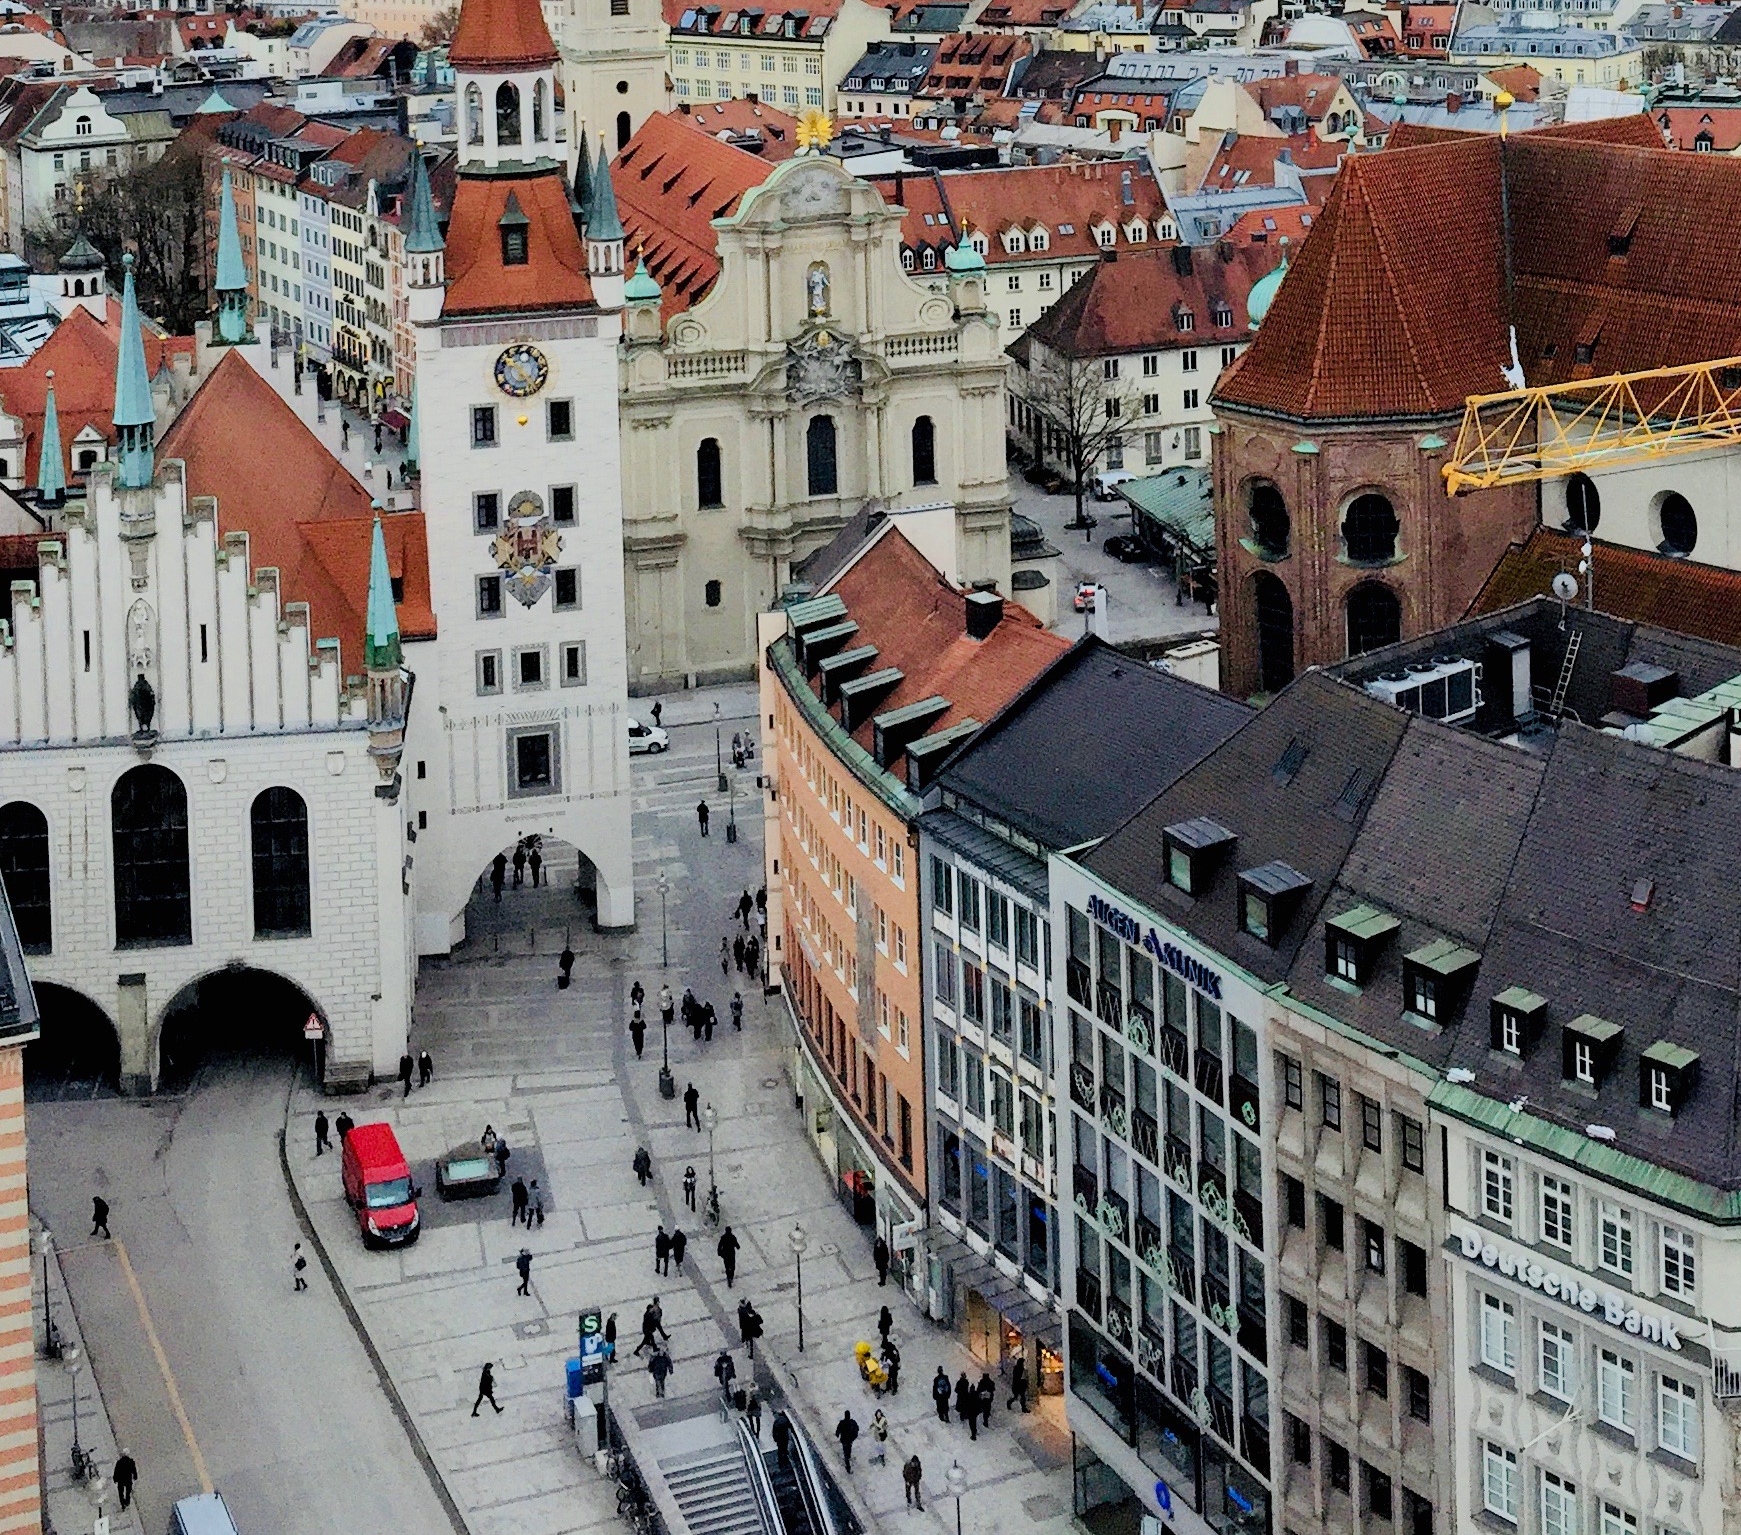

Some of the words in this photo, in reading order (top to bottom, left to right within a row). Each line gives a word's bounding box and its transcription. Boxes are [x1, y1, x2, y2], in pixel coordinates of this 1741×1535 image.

[1086, 894, 1140, 945] AUGEN
[1163, 942, 1223, 1000] KLINIK
[584, 1315, 598, 1333] S
[1461, 1227, 1598, 1313] Deutsche
[1604, 1292, 1682, 1351] Bank
